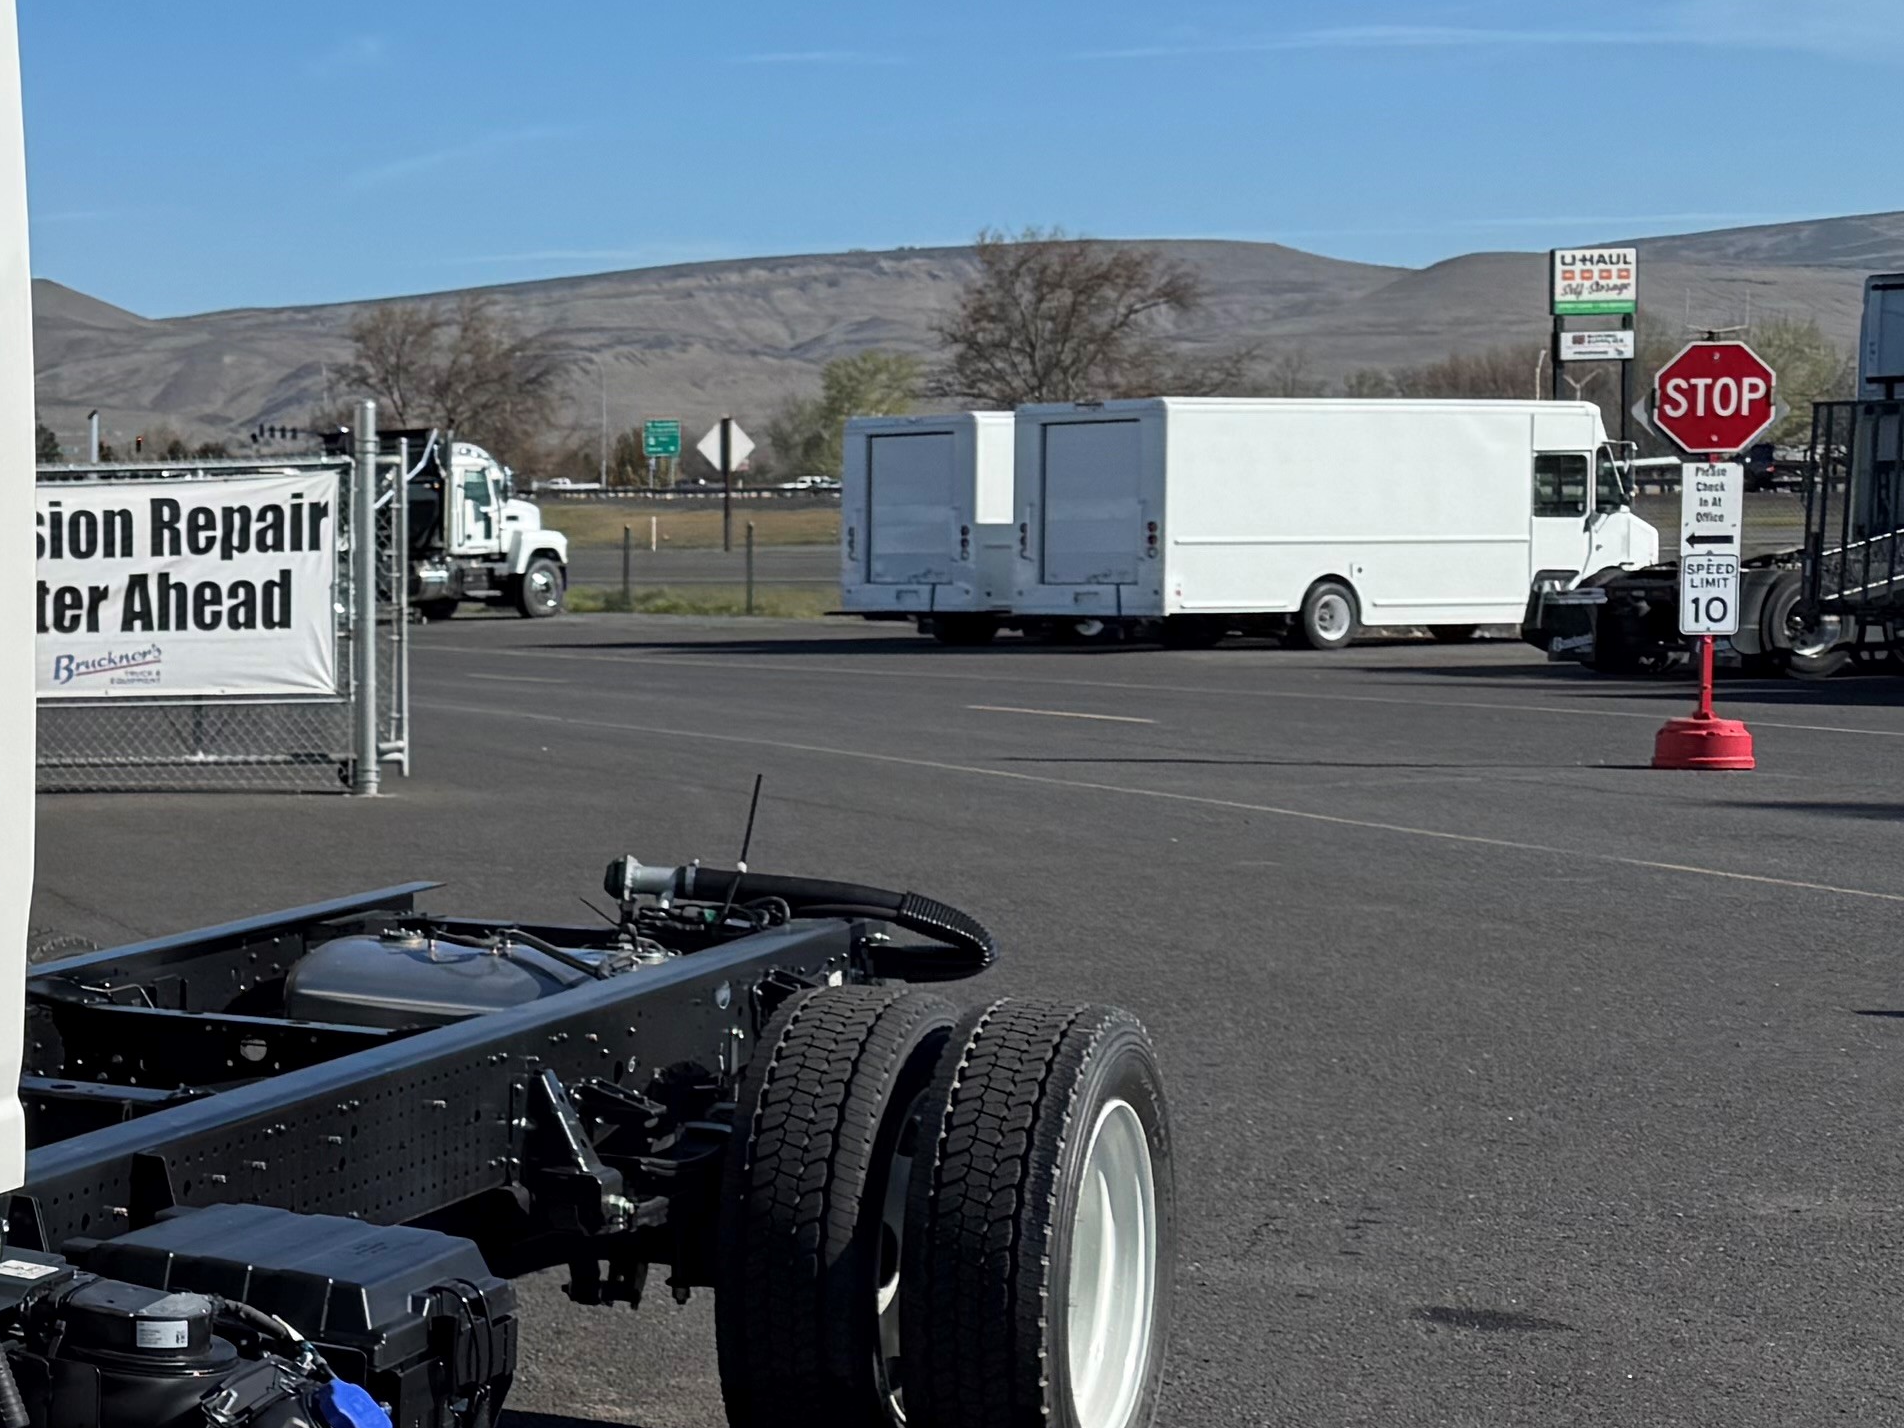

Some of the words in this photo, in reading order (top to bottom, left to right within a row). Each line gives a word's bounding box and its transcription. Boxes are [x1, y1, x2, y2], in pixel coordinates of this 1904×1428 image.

[1663, 376, 1767, 418] STOP
[1695, 466, 1727, 477] Please
[1696, 481, 1725, 492] Check
[1699, 497, 1710, 508] In
[1711, 497, 1722, 508] At
[1696, 512, 1724, 523] Office
[150, 492, 329, 561] Repair
[1687, 563, 1736, 575] SPEED
[1690, 577, 1730, 588] LIMIT
[120, 569, 292, 633] Ahead
[1691, 596, 1728, 623] 10
[53, 643, 162, 685] Bruckner's
